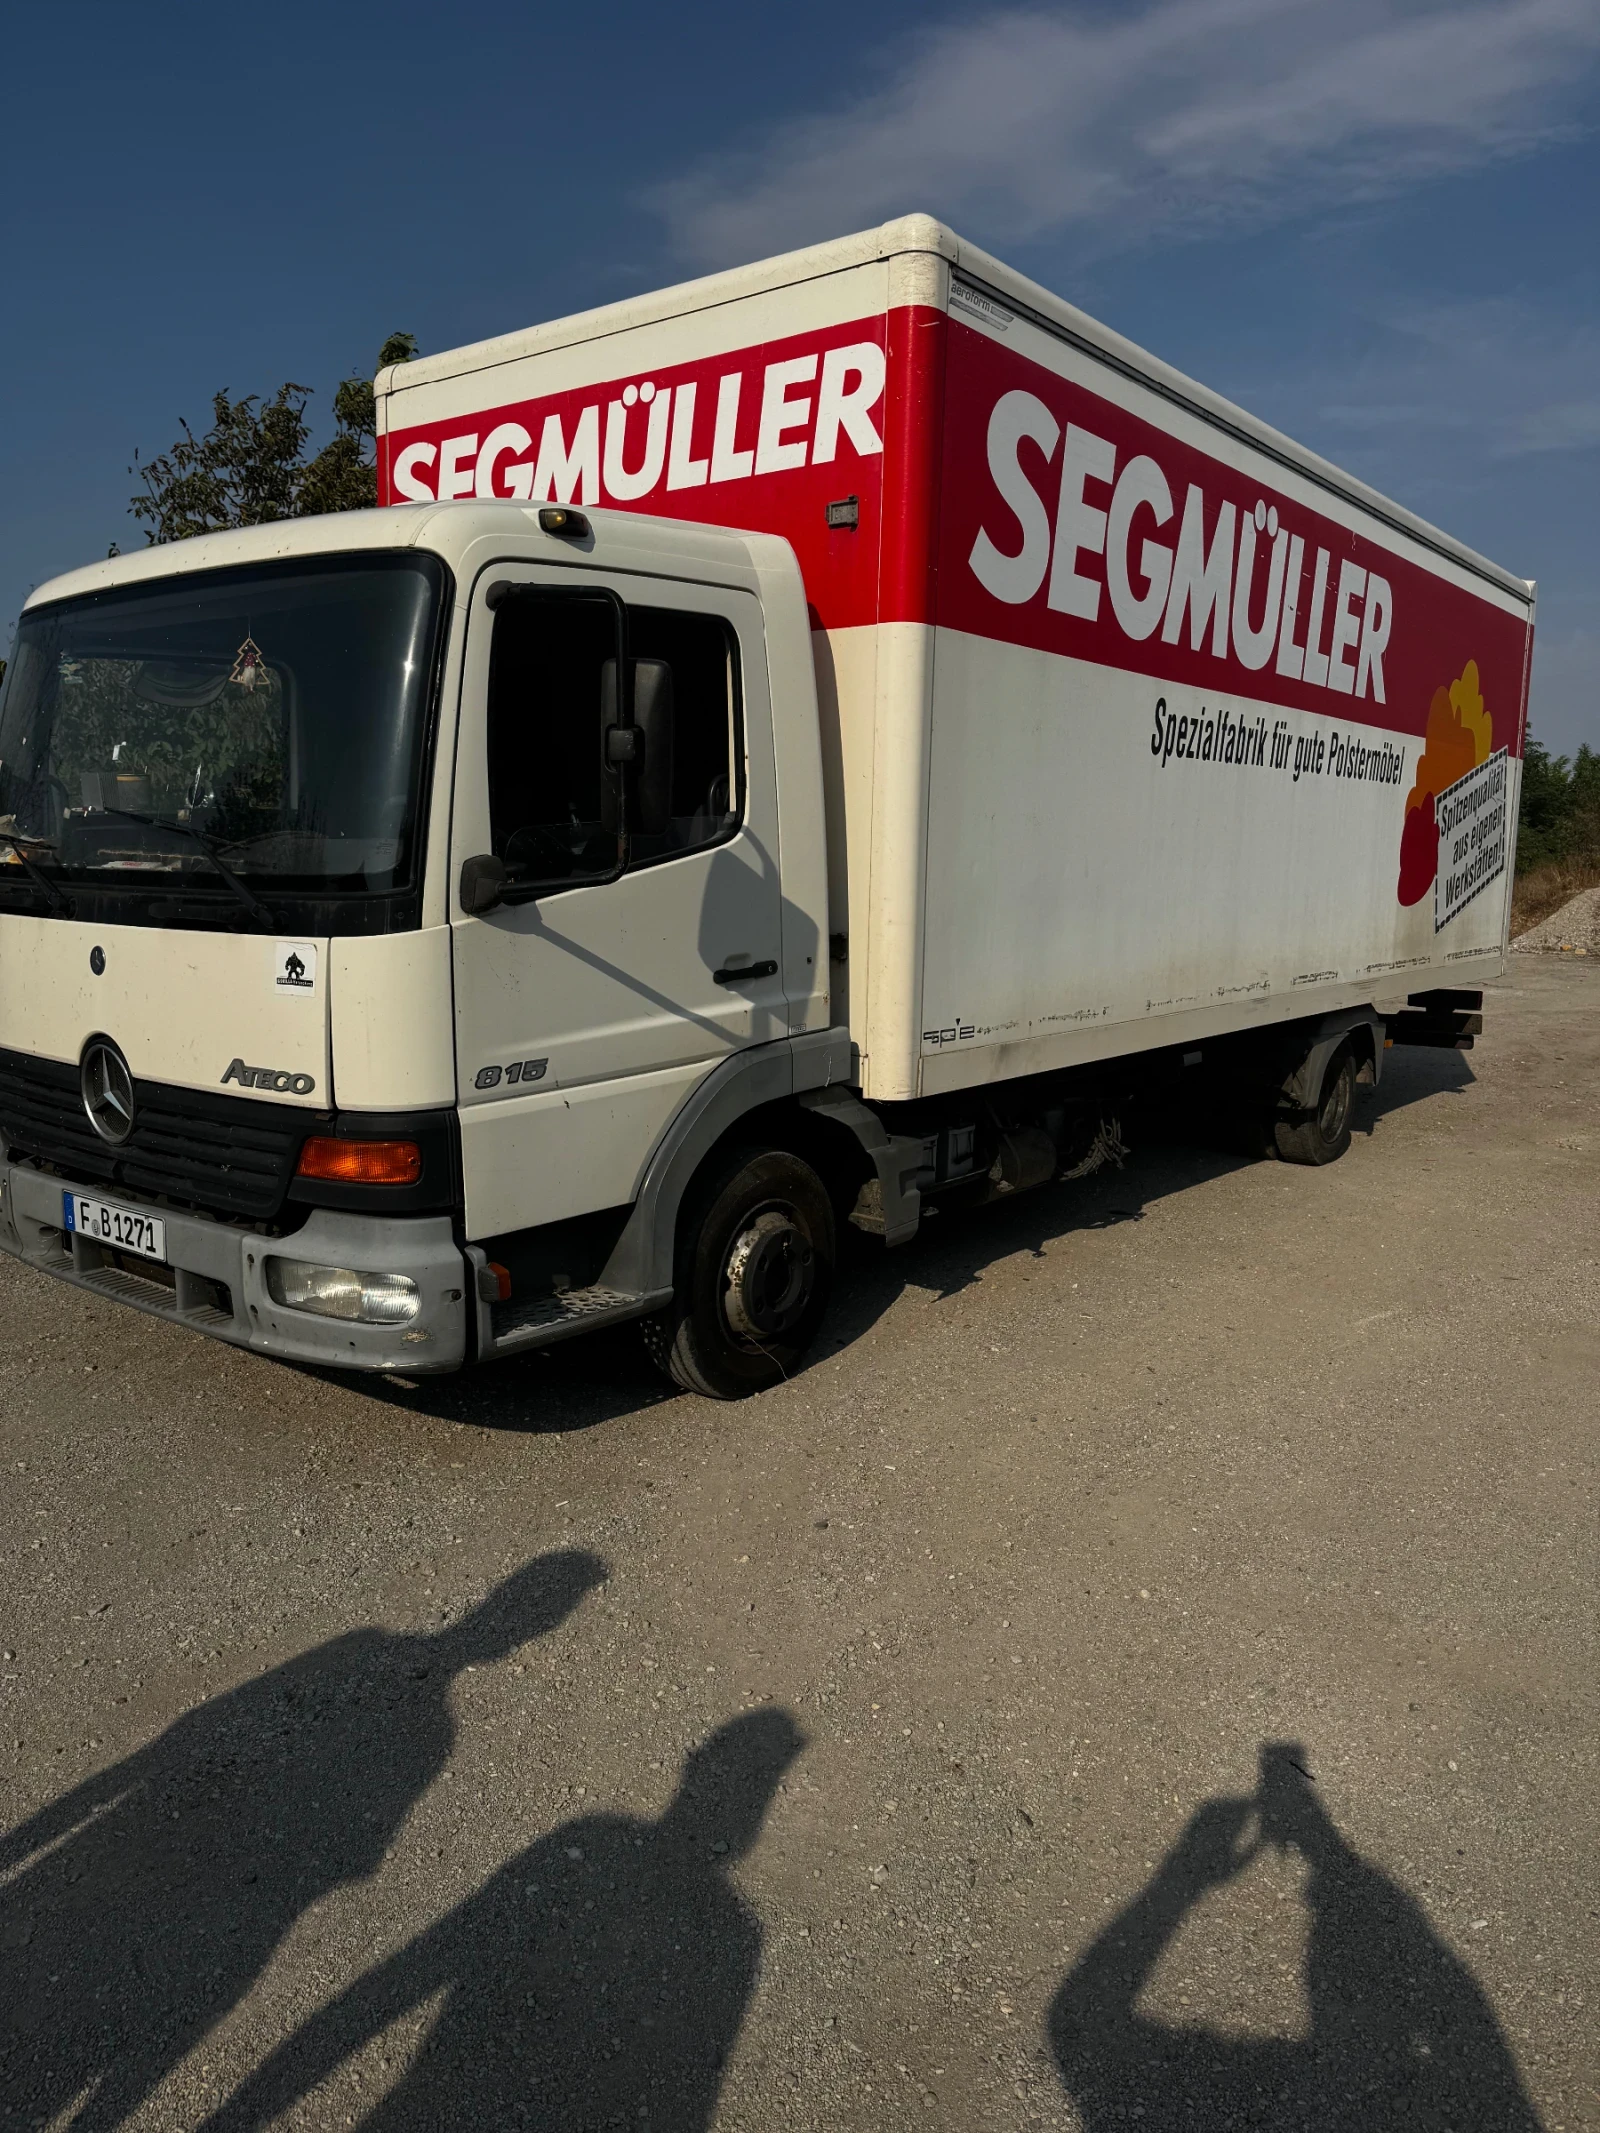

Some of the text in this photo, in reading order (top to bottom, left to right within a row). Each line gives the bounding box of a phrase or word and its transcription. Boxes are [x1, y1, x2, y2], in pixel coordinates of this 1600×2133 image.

[951, 283, 991, 312] aeroform
[394, 341, 885, 506] SEGMÜLLER
[968, 389, 1393, 704] SEGMÜLLER
[1151, 697, 1405, 785] Spezialfabrik für gute Polstermöbel
[1440, 763, 1504, 840] Spitzenqualität
[1453, 804, 1502, 865] aus eigenen
[1446, 832, 1502, 909] Werkstätten!
[475, 1057, 549, 1089] 815
[80, 1201, 90, 1229] F
[100, 1207, 156, 1253] B1271
